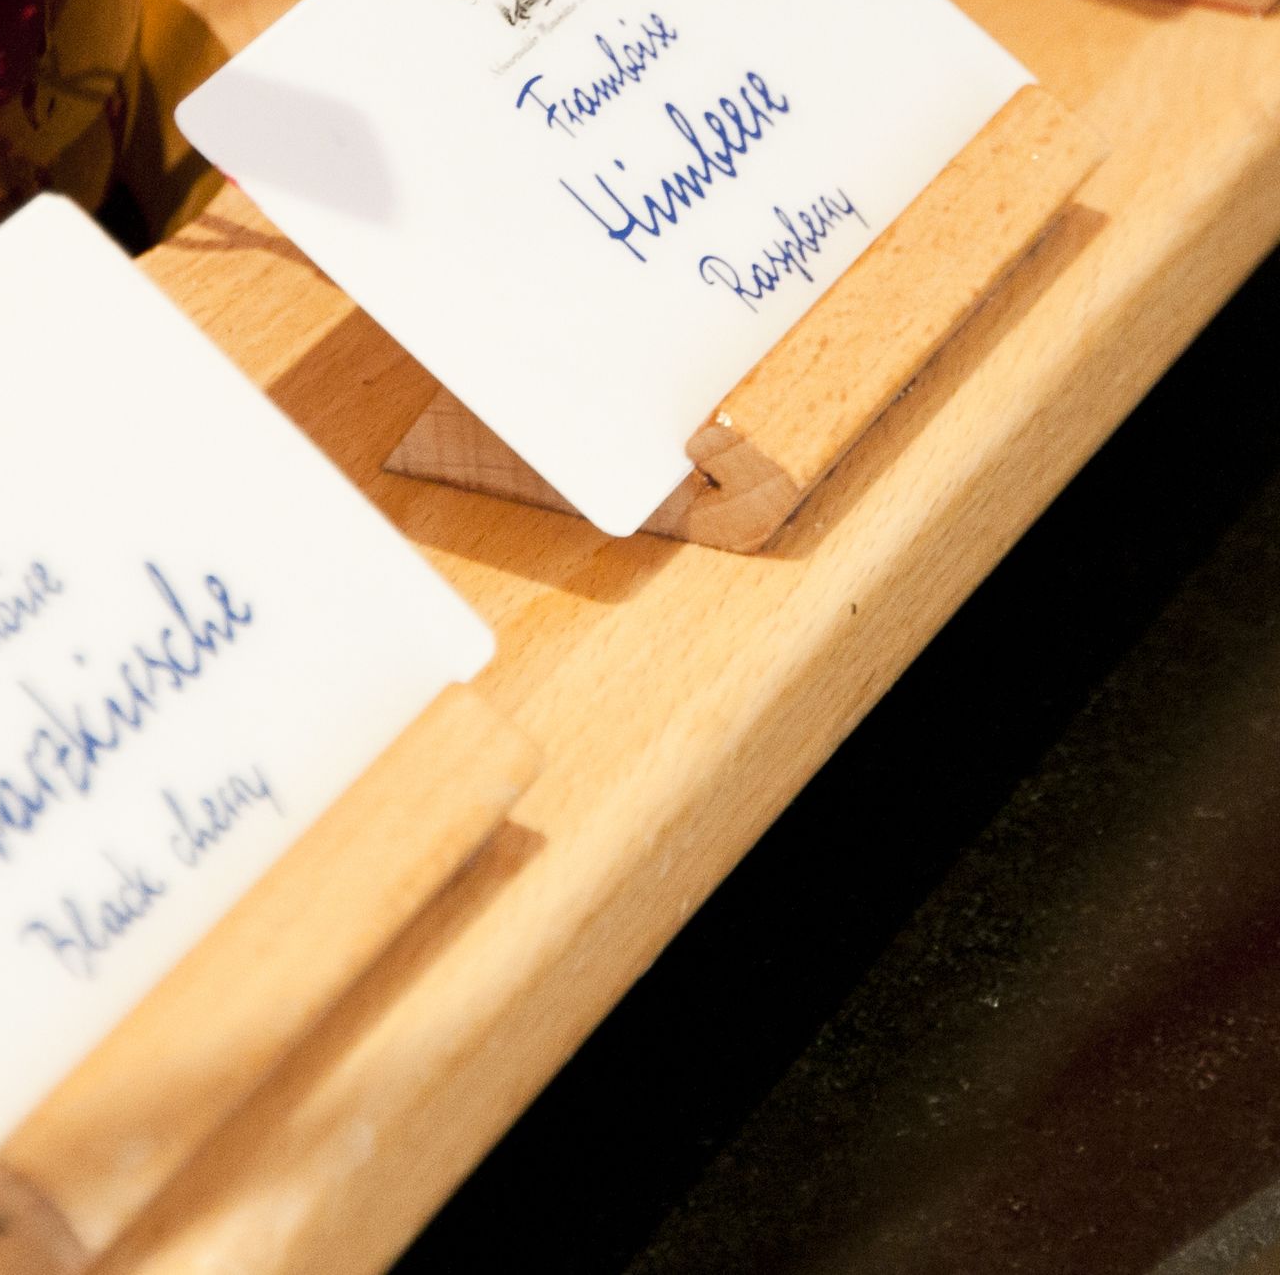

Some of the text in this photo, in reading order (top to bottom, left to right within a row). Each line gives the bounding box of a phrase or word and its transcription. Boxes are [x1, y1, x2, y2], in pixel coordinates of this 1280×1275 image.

[515, 12, 679, 138] Framboise
[558, 71, 791, 264] Himbeere
[698, 188, 871, 314] Raspberry
[163, 763, 285, 868] cherry
